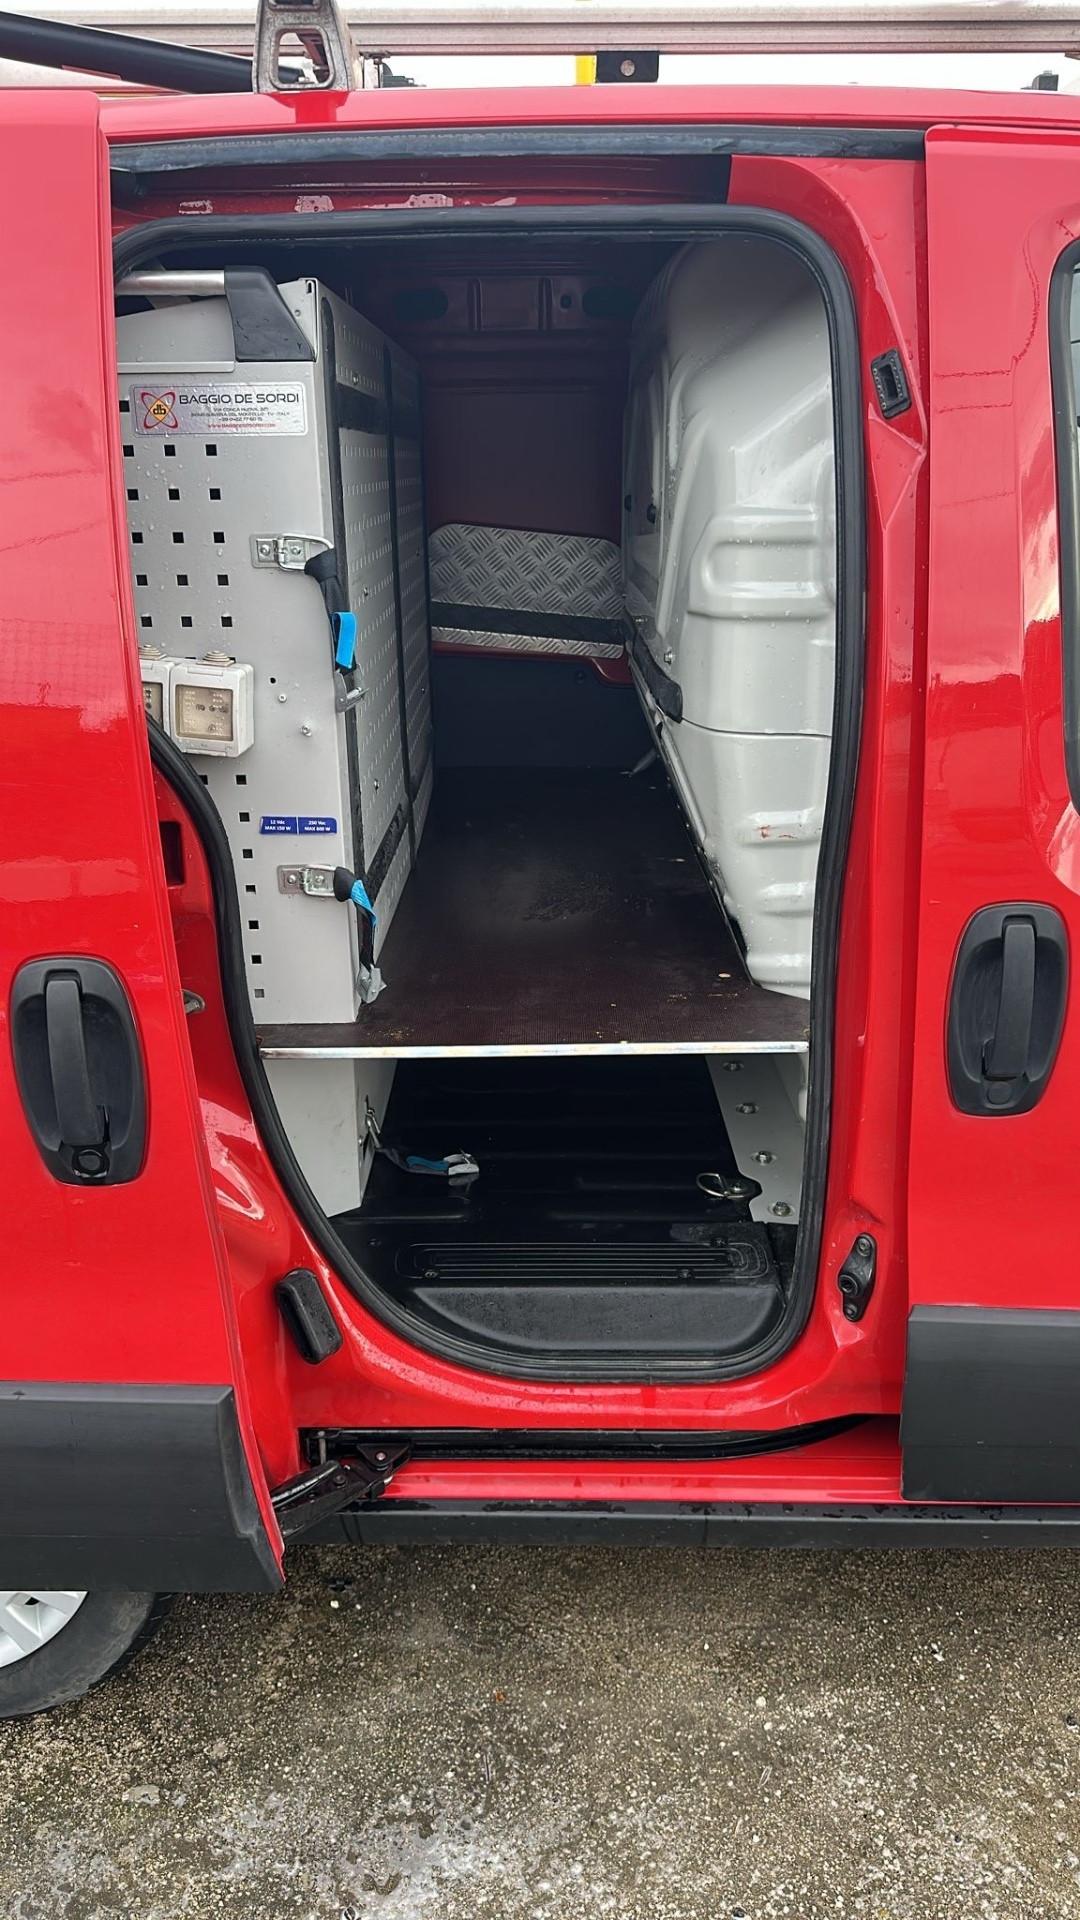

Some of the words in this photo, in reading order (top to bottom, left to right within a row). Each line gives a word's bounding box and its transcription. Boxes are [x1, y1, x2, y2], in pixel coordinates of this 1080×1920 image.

[179, 394, 232, 404] BAGGIO
[234, 394, 253, 404] DE
[256, 393, 299, 403] SORDI
